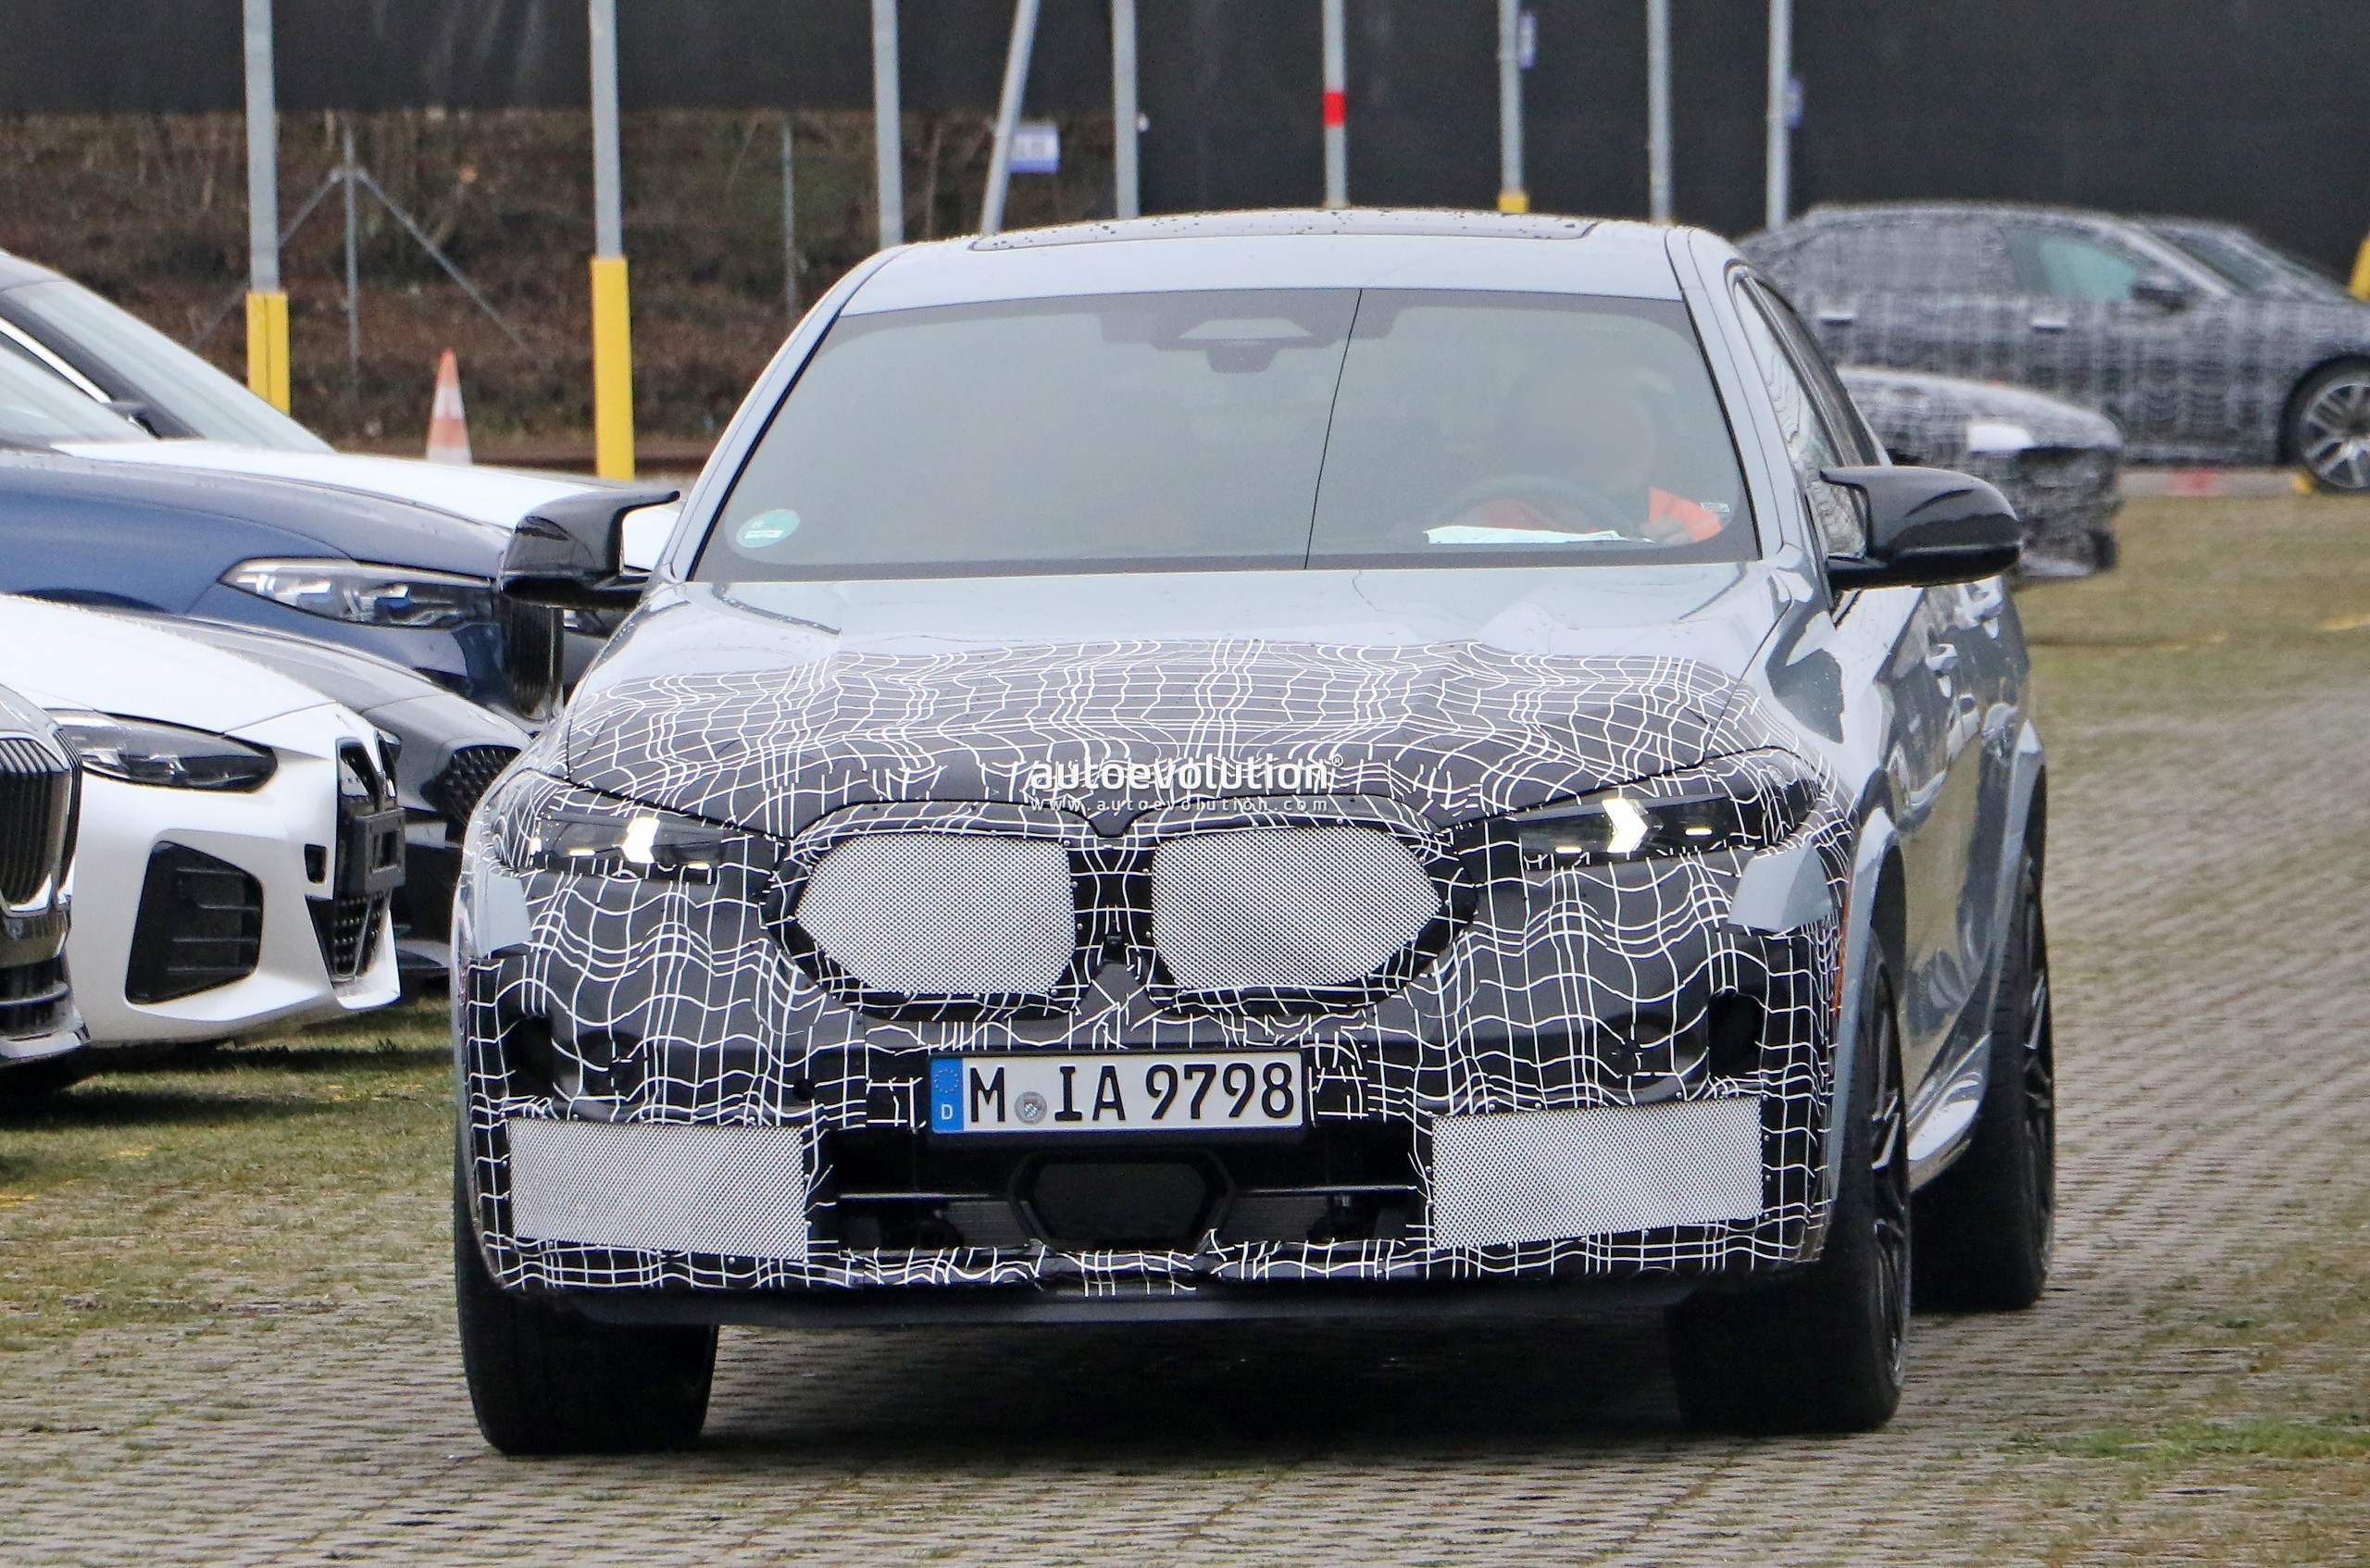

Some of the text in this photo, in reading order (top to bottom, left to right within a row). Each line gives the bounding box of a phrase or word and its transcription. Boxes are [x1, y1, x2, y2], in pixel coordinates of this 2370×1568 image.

[941, 1103, 954, 1121] D
[969, 1065, 1006, 1123] M
[1144, 1062, 1295, 1120] 9798
